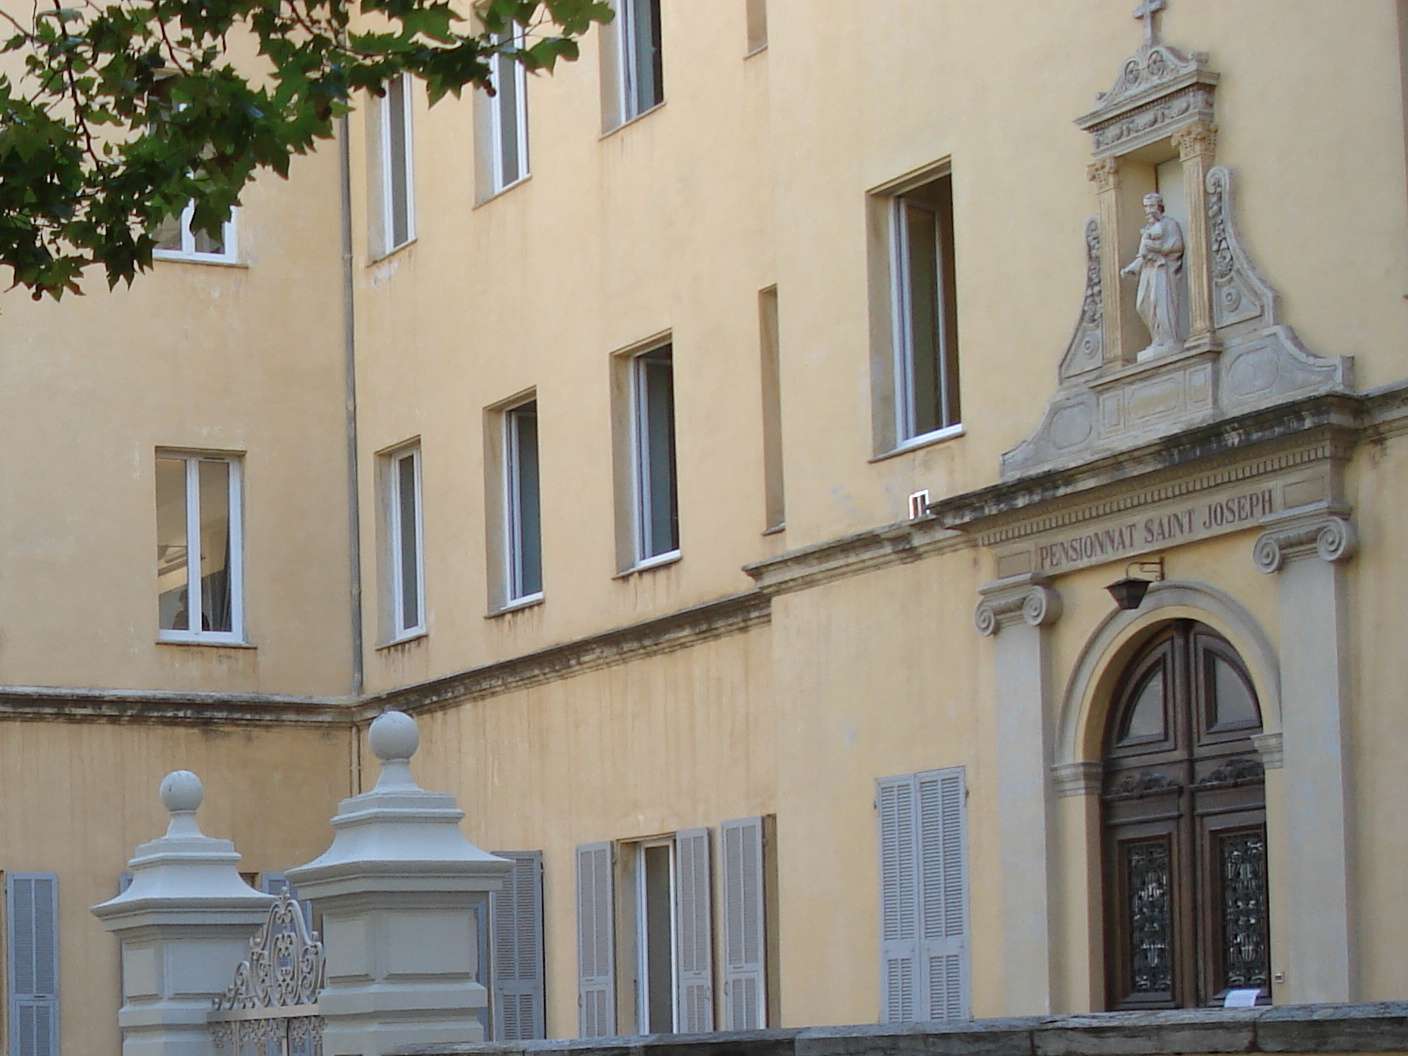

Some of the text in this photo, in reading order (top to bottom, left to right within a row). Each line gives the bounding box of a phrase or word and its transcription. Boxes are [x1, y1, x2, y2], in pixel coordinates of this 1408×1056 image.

[1040, 489, 1274, 569] PENSIONNAT SAINT JOSEPH
